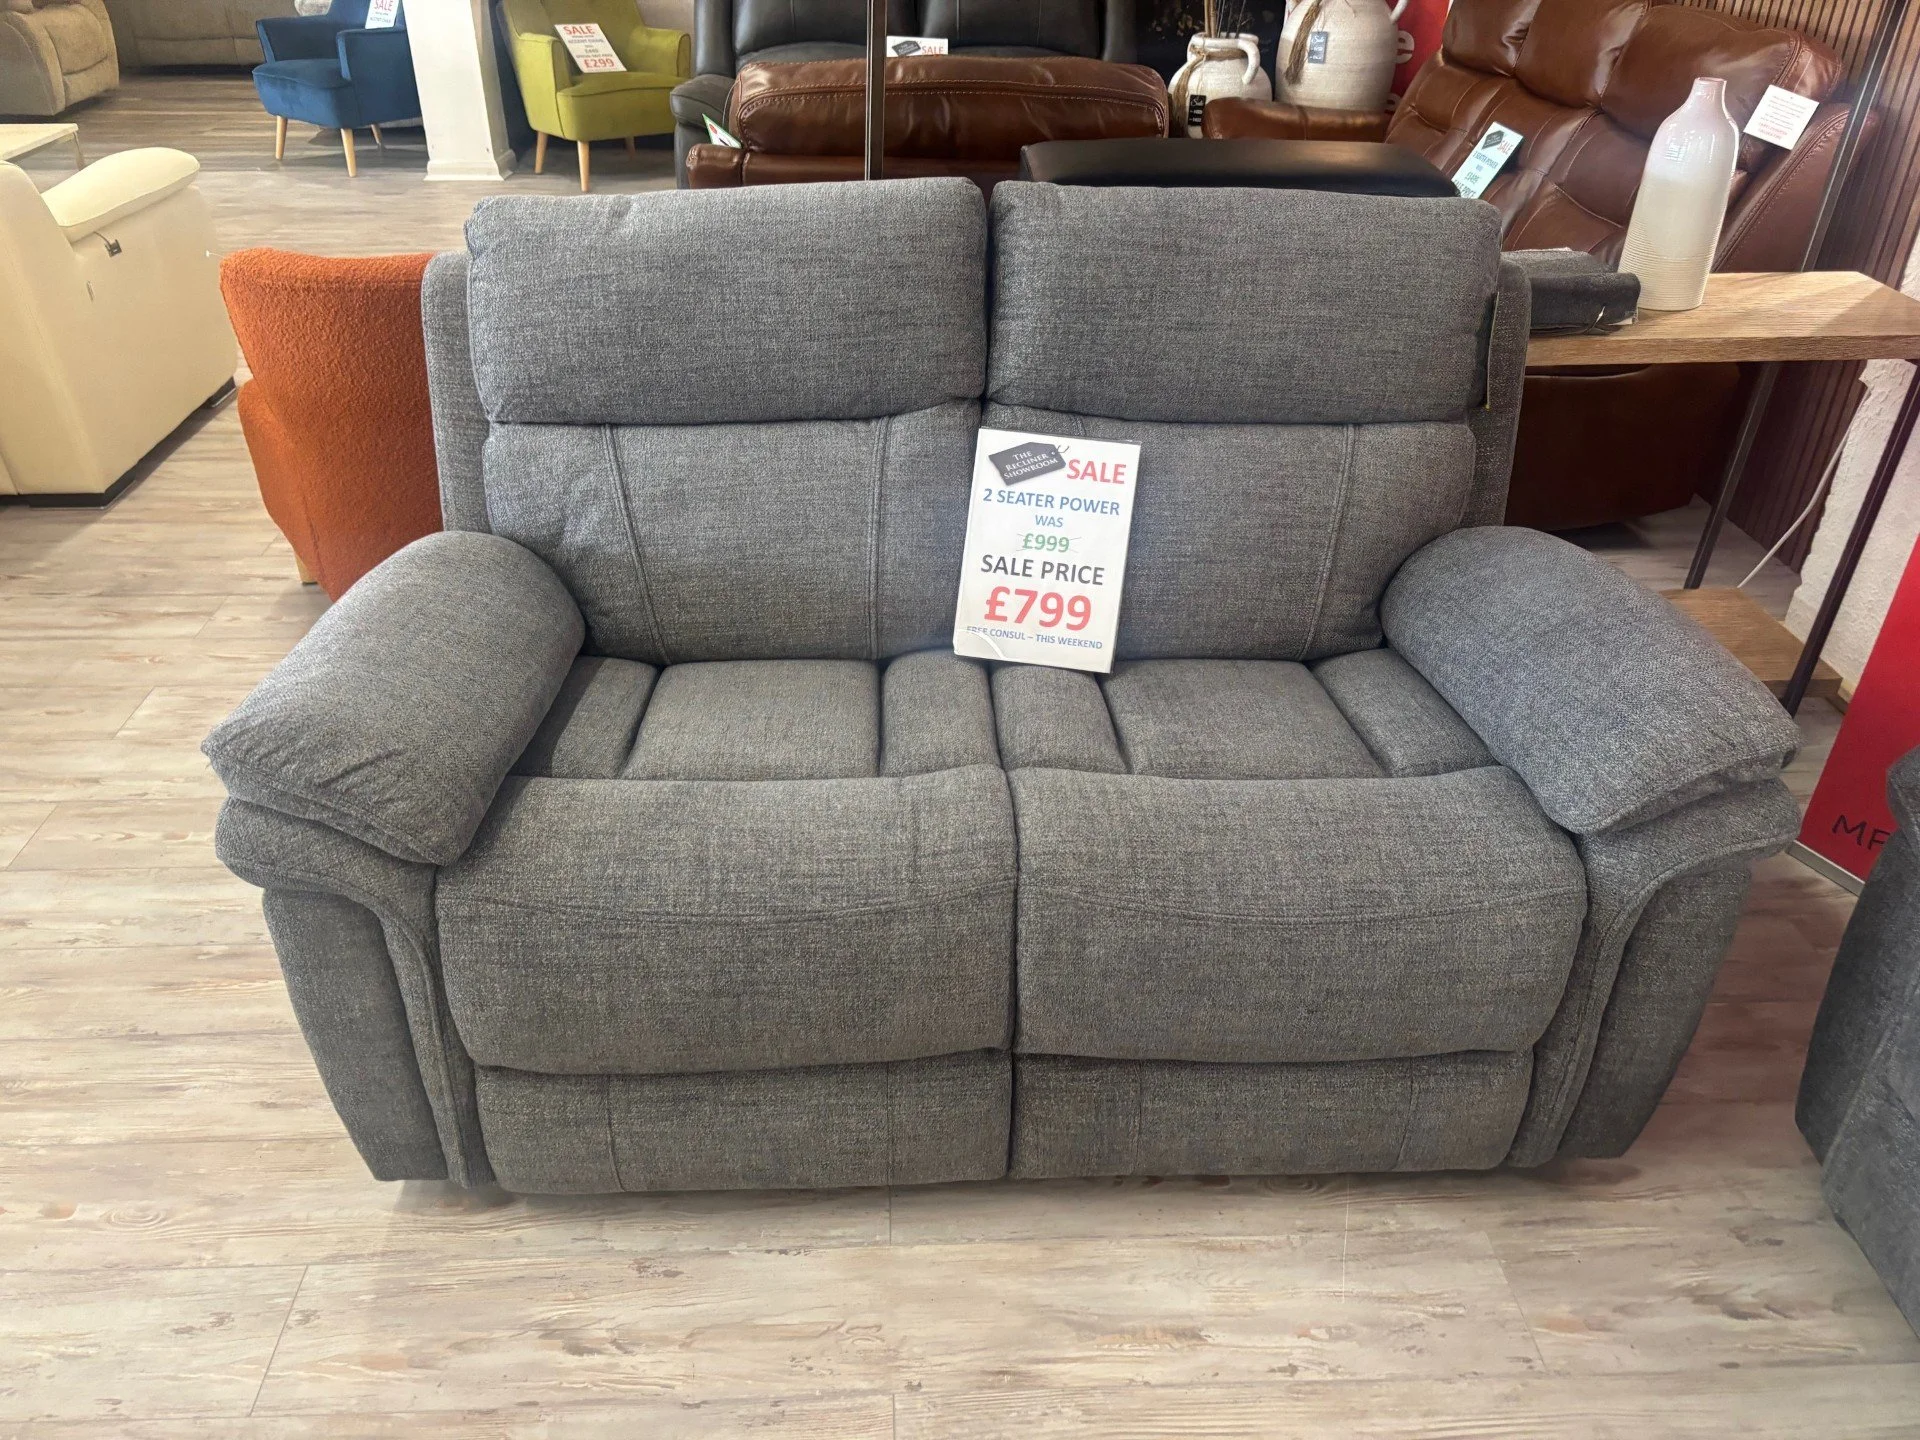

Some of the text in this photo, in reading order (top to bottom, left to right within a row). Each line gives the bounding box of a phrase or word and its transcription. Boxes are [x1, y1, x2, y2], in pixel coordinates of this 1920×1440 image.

[374, 0, 393, 11] SALE
[563, 26, 594, 34] SALE
[922, 46, 944, 55] SALE
[584, 58, 614, 68] £299
[1497, 140, 1514, 154] SALE
[1005, 453, 1049, 471] RECLINER
[1012, 450, 1032, 461] THE
[1004, 458, 1058, 479] SHOWROOM
[1067, 458, 1126, 485] SALE
[983, 488, 1120, 515] 2 SEATER POWER
[1035, 515, 1064, 528] WAS
[1022, 532, 1070, 553] £999
[980, 554, 1105, 585] SALE PRICE
[984, 585, 1092, 631] £799
[989, 629, 1025, 640] CONSUL
[1036, 634, 1055, 644] THIS
[1057, 636, 1103, 649] WEEKEND
